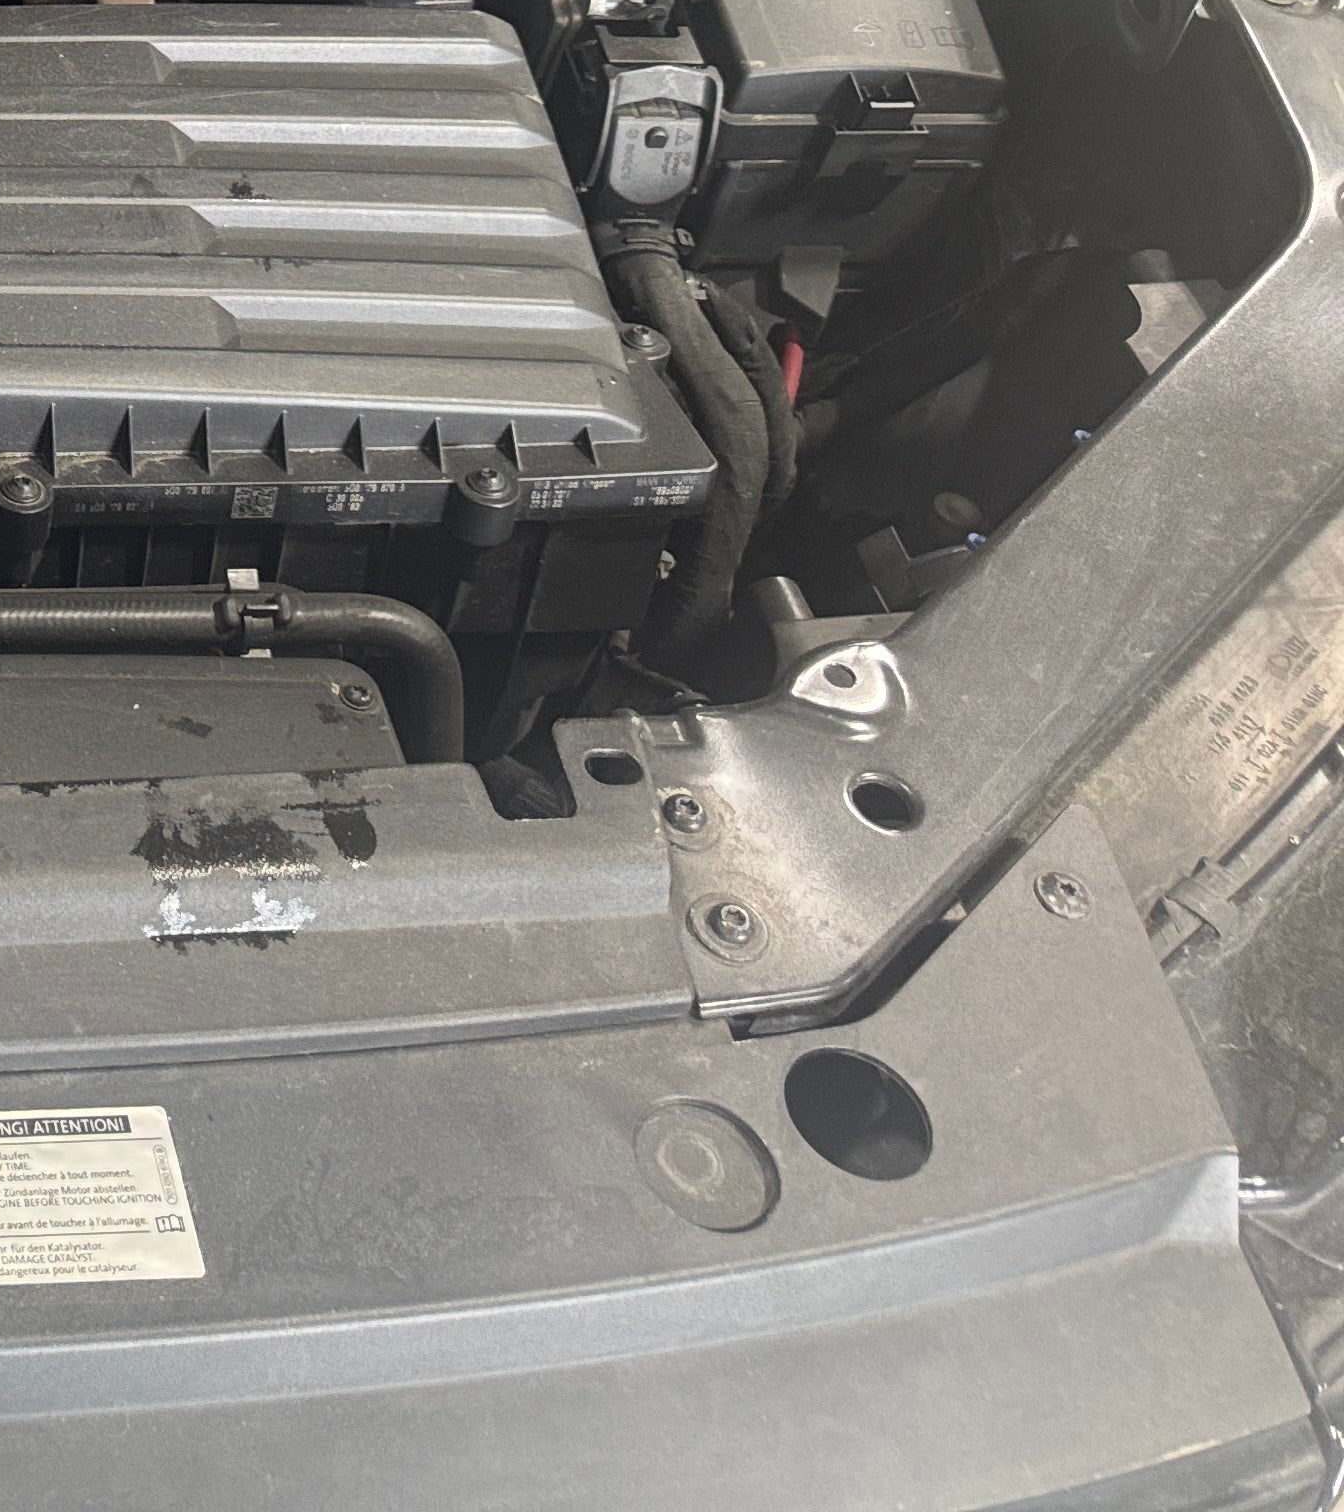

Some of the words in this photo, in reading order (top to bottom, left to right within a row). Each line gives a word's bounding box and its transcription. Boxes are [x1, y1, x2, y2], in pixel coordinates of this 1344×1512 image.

[33, 1117, 124, 1134] ATTENTION!
[67, 1170, 88, 1179] tout
[61, 1186, 91, 1194] Motor
[24, 1196, 60, 1207] BEFORE
[62, 1195, 114, 1206] TOUCHING
[116, 1194, 162, 1204] IGNITION
[7, 1221, 34, 1230] avant
[36, 1220, 48, 1228] de
[50, 1219, 88, 1228] toucher
[10, 1244, 26, 1252] für
[28, 1244, 46, 1252] den
[2, 1254, 45, 1264] DAMAGE
[53, 1267, 74, 1276] pour
[76, 1264, 86, 1273] le
